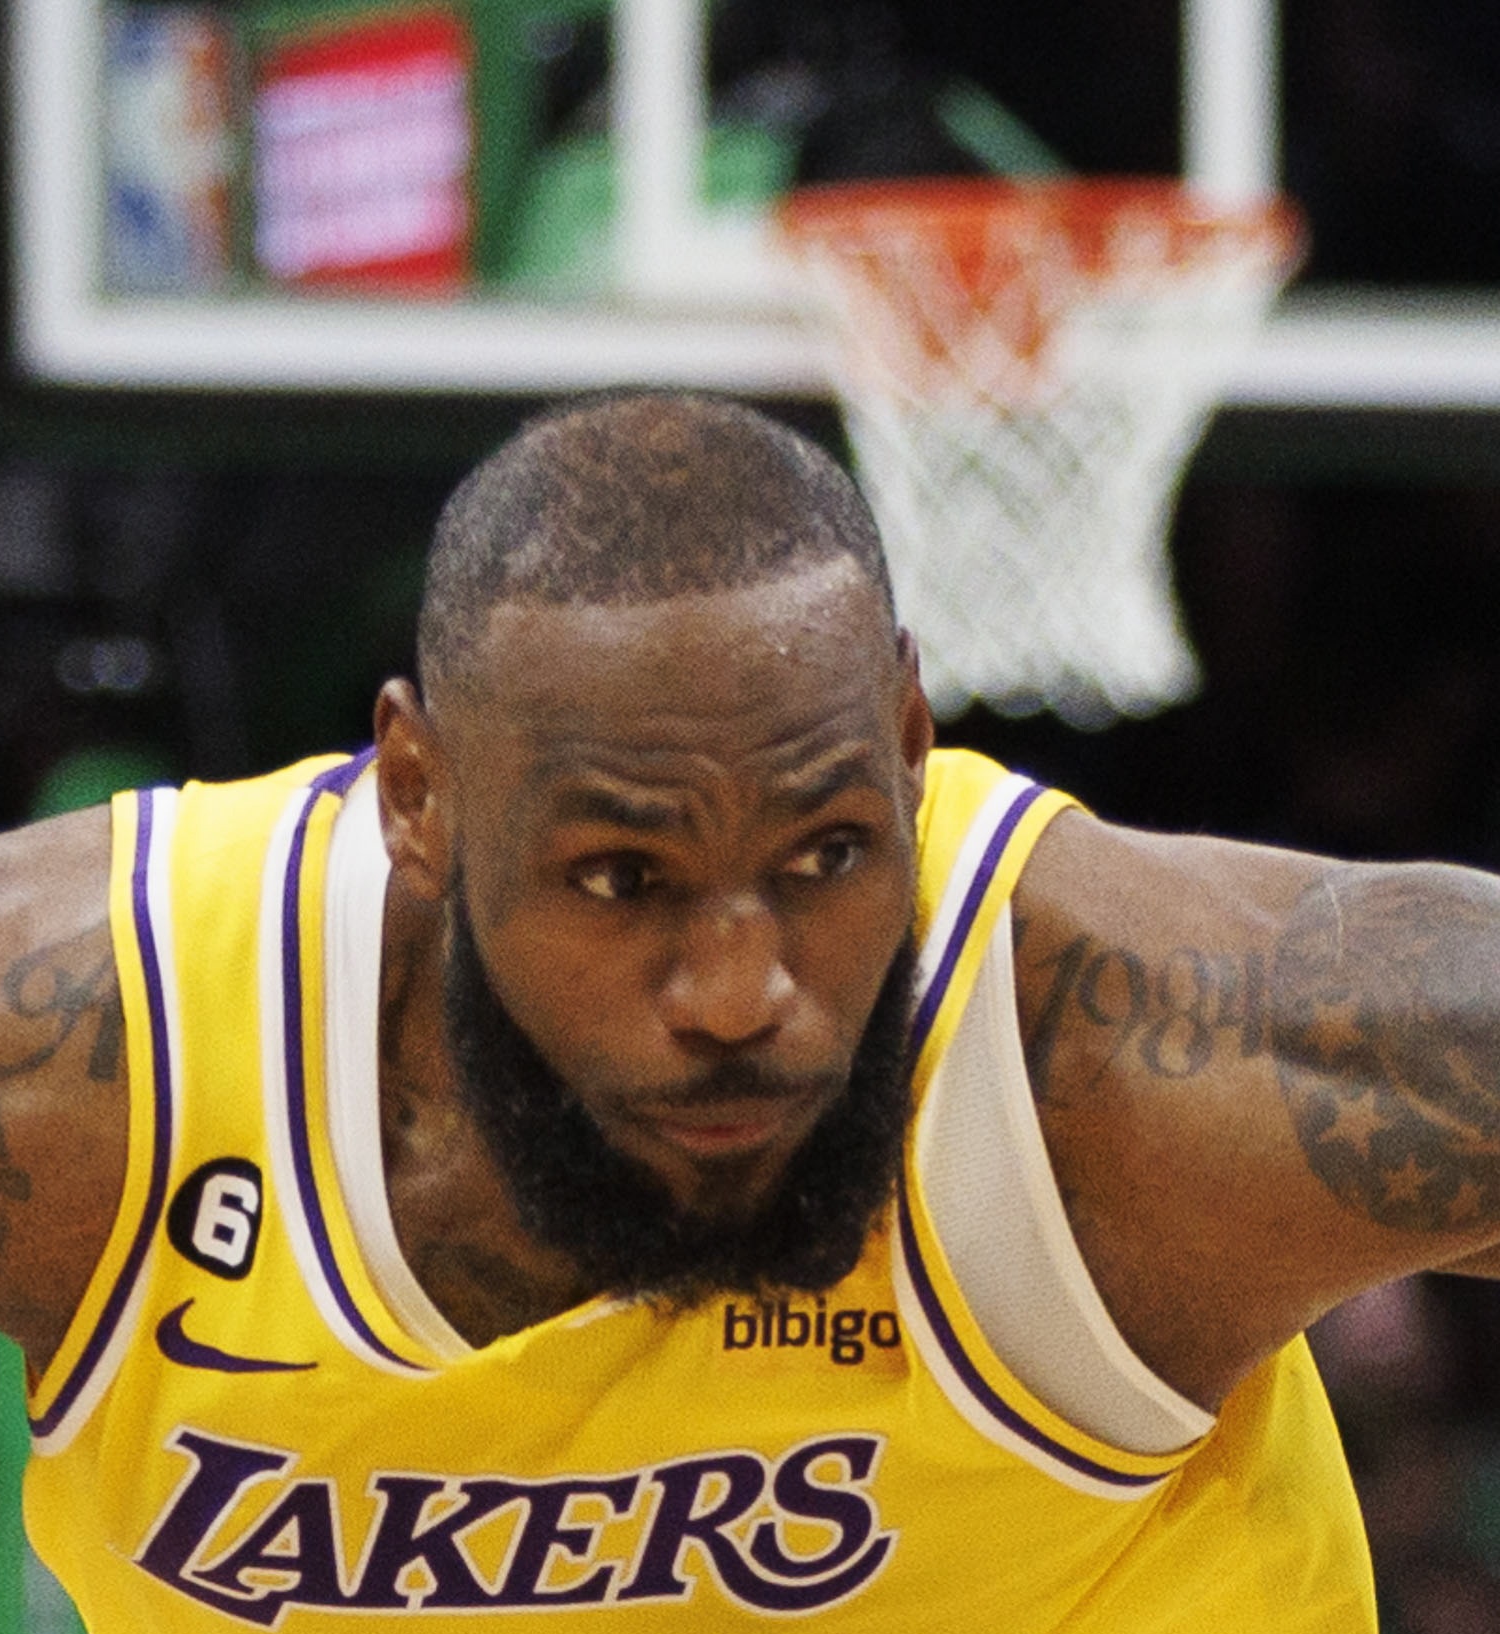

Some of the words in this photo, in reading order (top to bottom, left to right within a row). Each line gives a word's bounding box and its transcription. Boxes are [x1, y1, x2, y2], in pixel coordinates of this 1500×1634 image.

[192, 1173, 261, 1269] 6
[722, 1297, 901, 1366] bibigo
[125, 1425, 898, 1631] LAKERS
